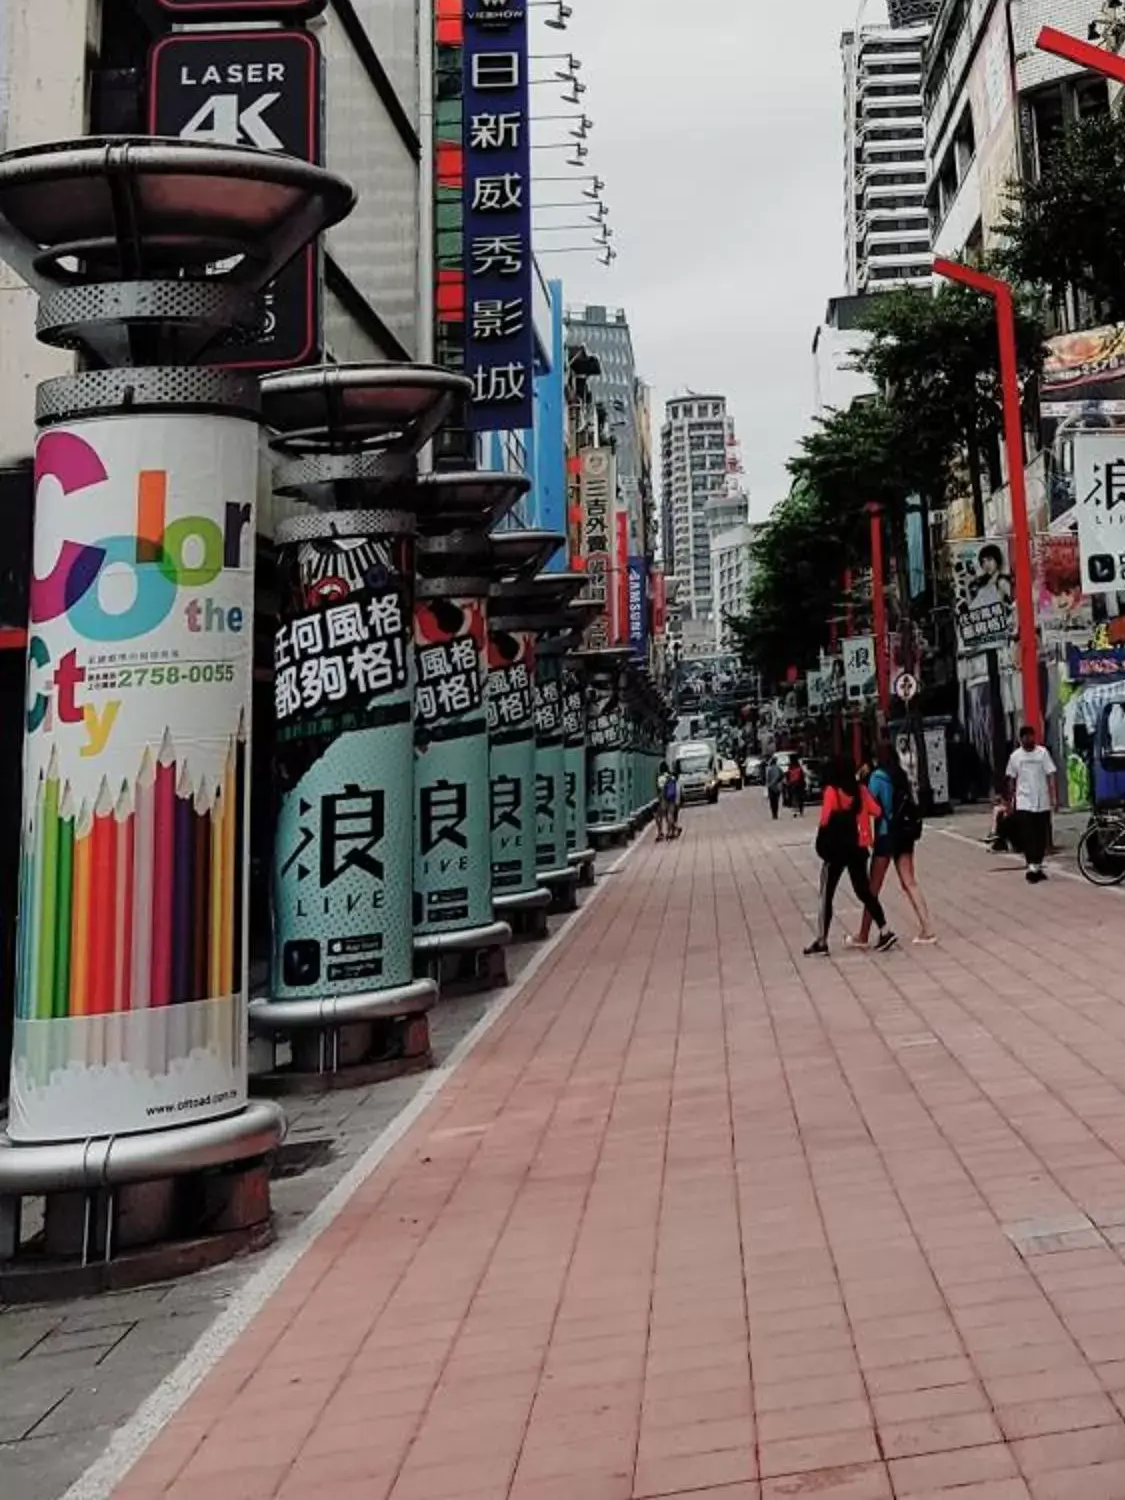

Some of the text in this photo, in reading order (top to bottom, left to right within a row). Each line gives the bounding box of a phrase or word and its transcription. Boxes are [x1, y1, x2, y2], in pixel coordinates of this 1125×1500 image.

[180, 63, 285, 85] LASER
[179, 92, 285, 149] 4K
[470, 51, 525, 402] 日新威秀影城
[184, 598, 243, 634] the
[118, 664, 235, 688] 2758-0055
[282, 784, 385, 888] 浪
[297, 889, 385, 917] LIVE
